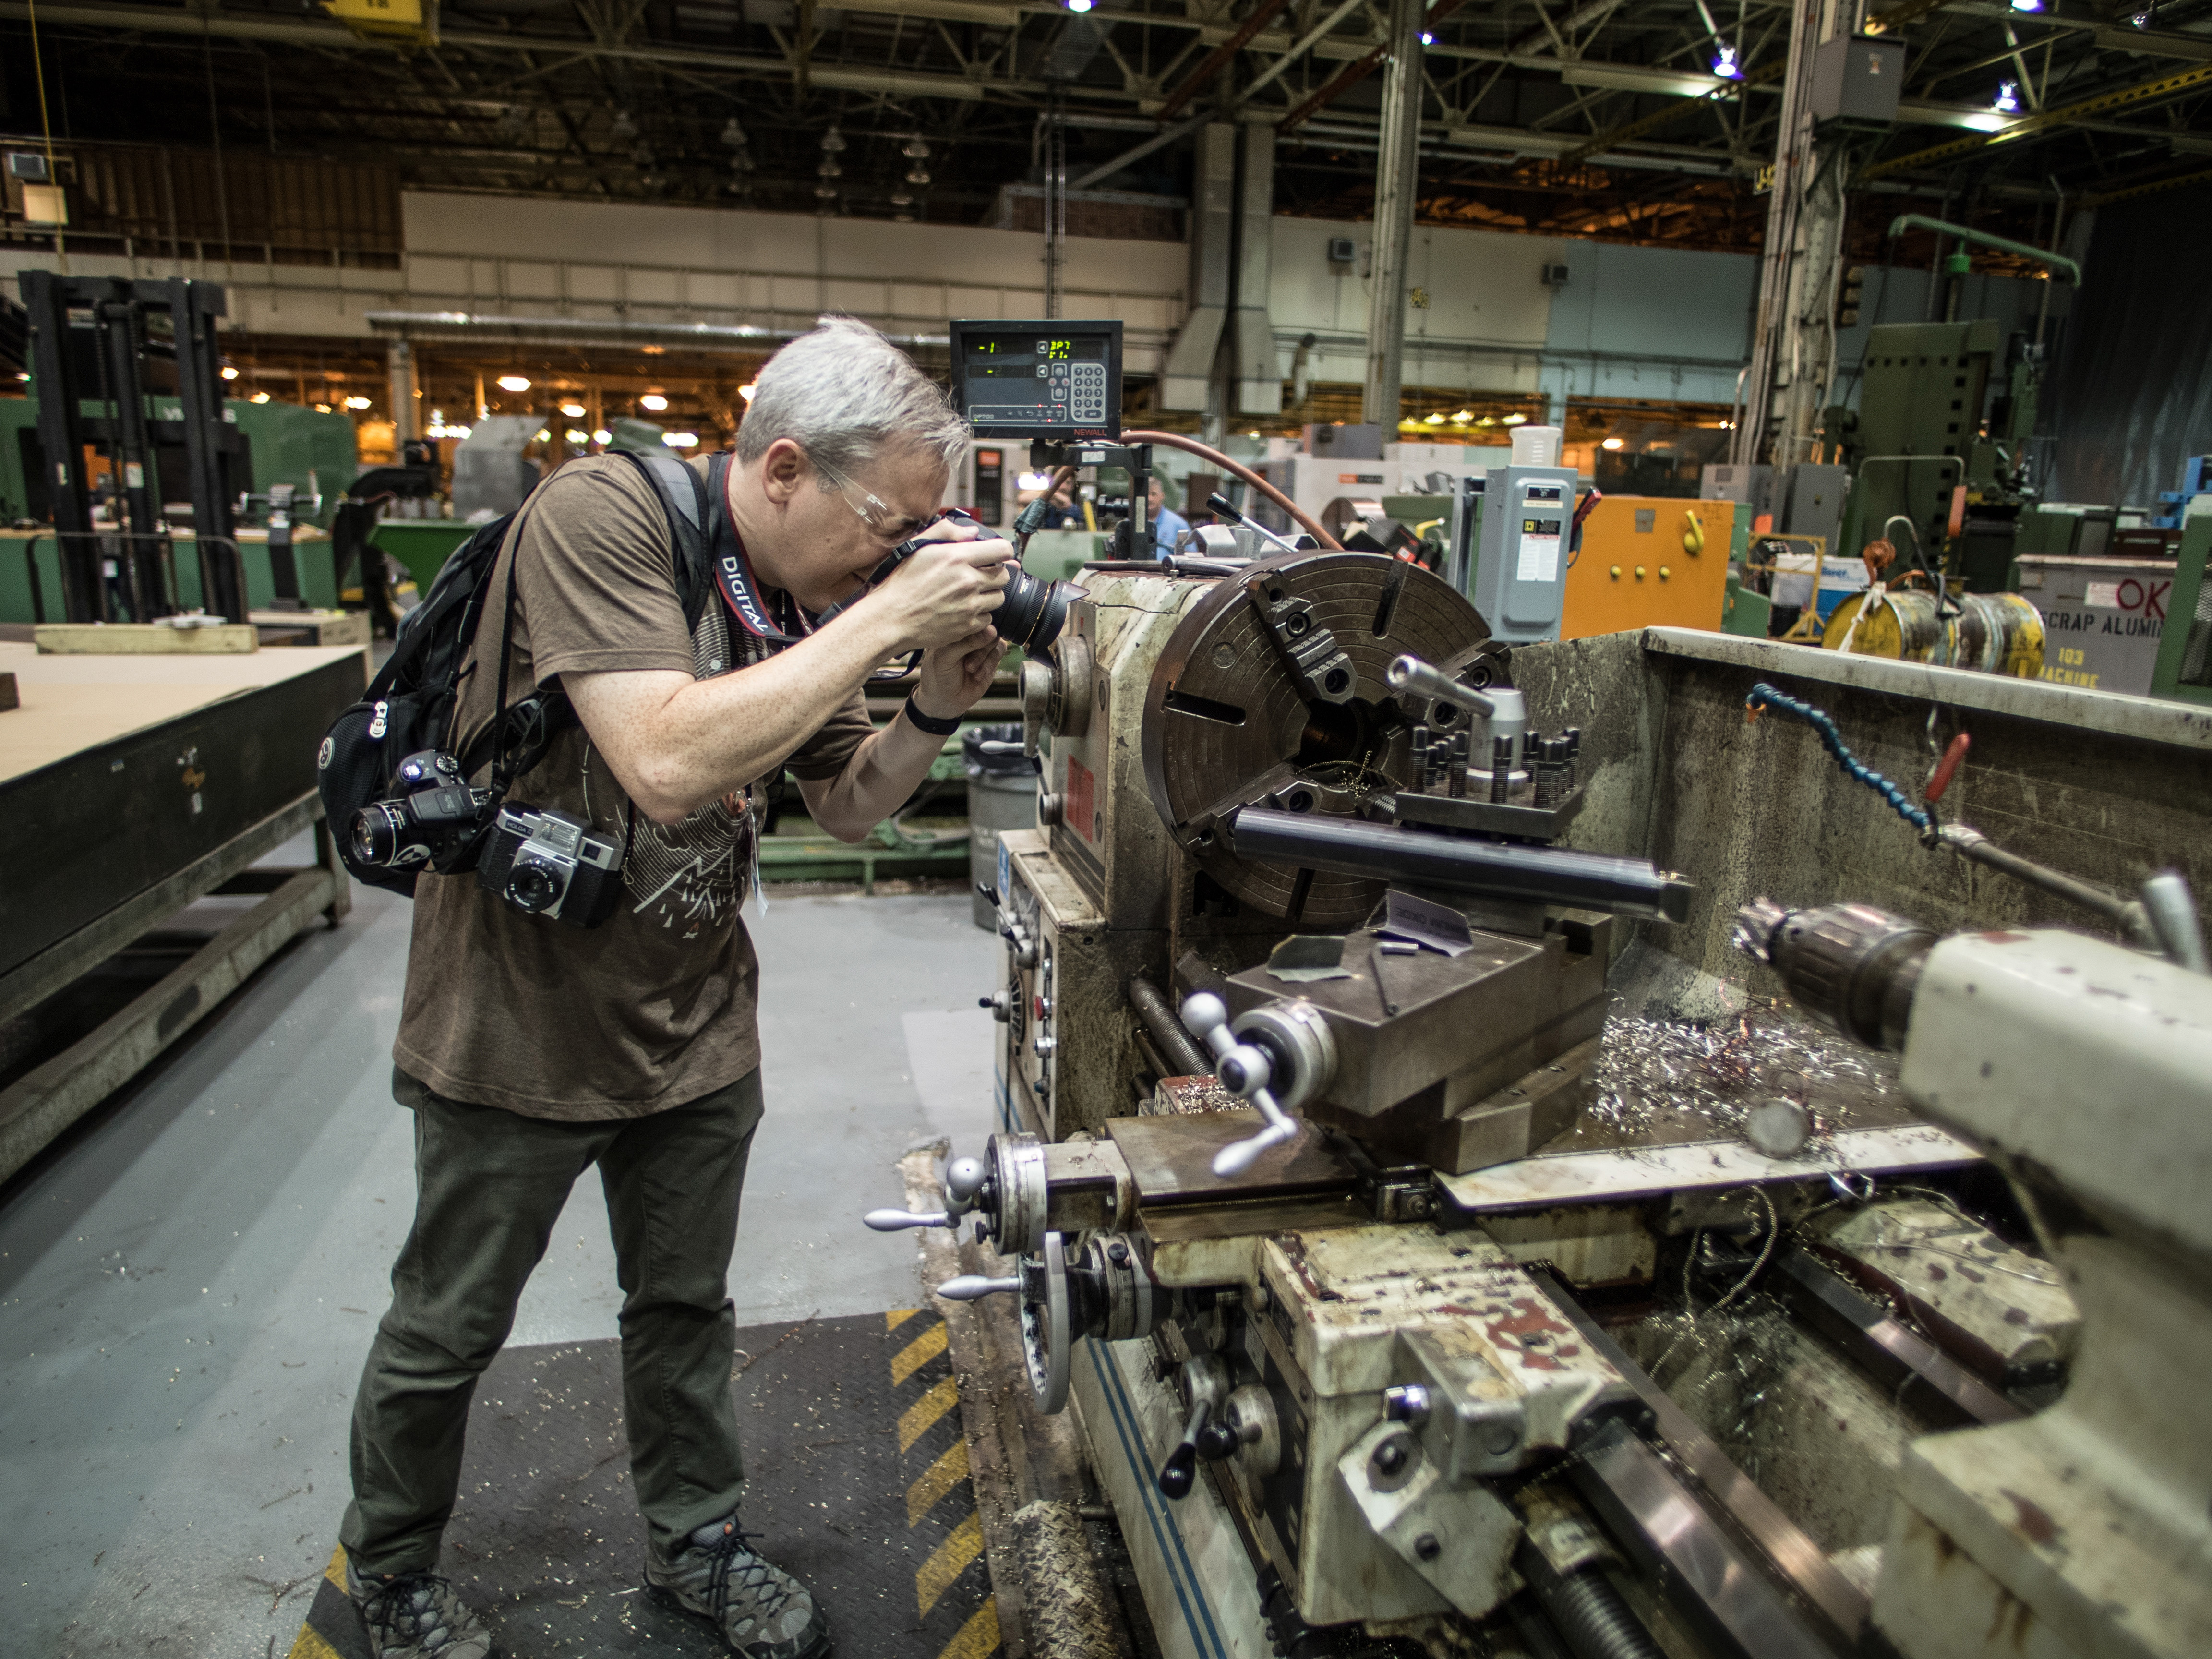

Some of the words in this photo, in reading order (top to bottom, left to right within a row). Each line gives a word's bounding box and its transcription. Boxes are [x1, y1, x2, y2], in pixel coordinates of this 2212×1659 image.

[1074, 428, 1107, 436] NEWALL
[722, 556, 769, 632] DIGITAL
[2117, 578, 2170, 620] OK
[2058, 648, 2084, 666] 103
[506, 821, 526, 833] HOLGA
